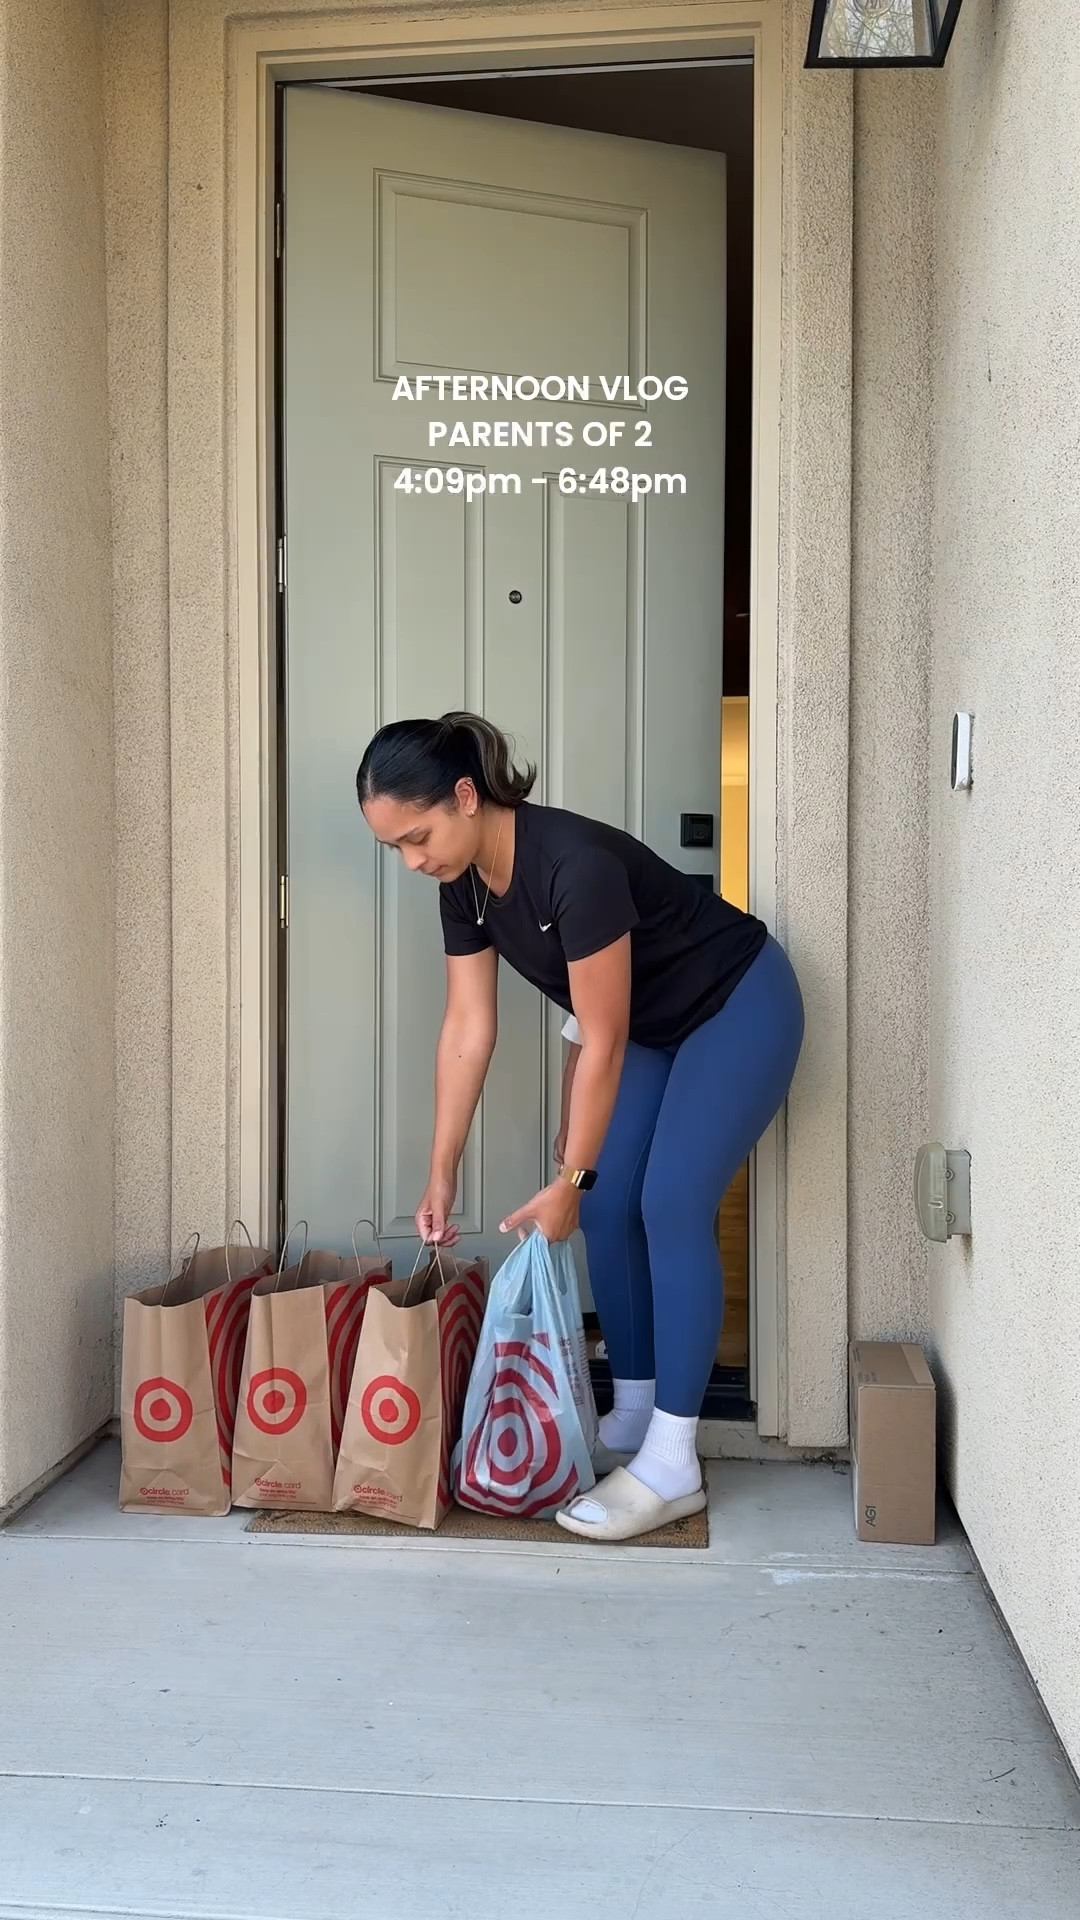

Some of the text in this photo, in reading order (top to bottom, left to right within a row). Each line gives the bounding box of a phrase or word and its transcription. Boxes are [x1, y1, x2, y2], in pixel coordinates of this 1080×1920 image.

[260, 1479, 301, 1489] circle card
[147, 1487, 189, 1496] circle card
[361, 1485, 385, 1496] circle
[865, 1504, 876, 1527] AG1
